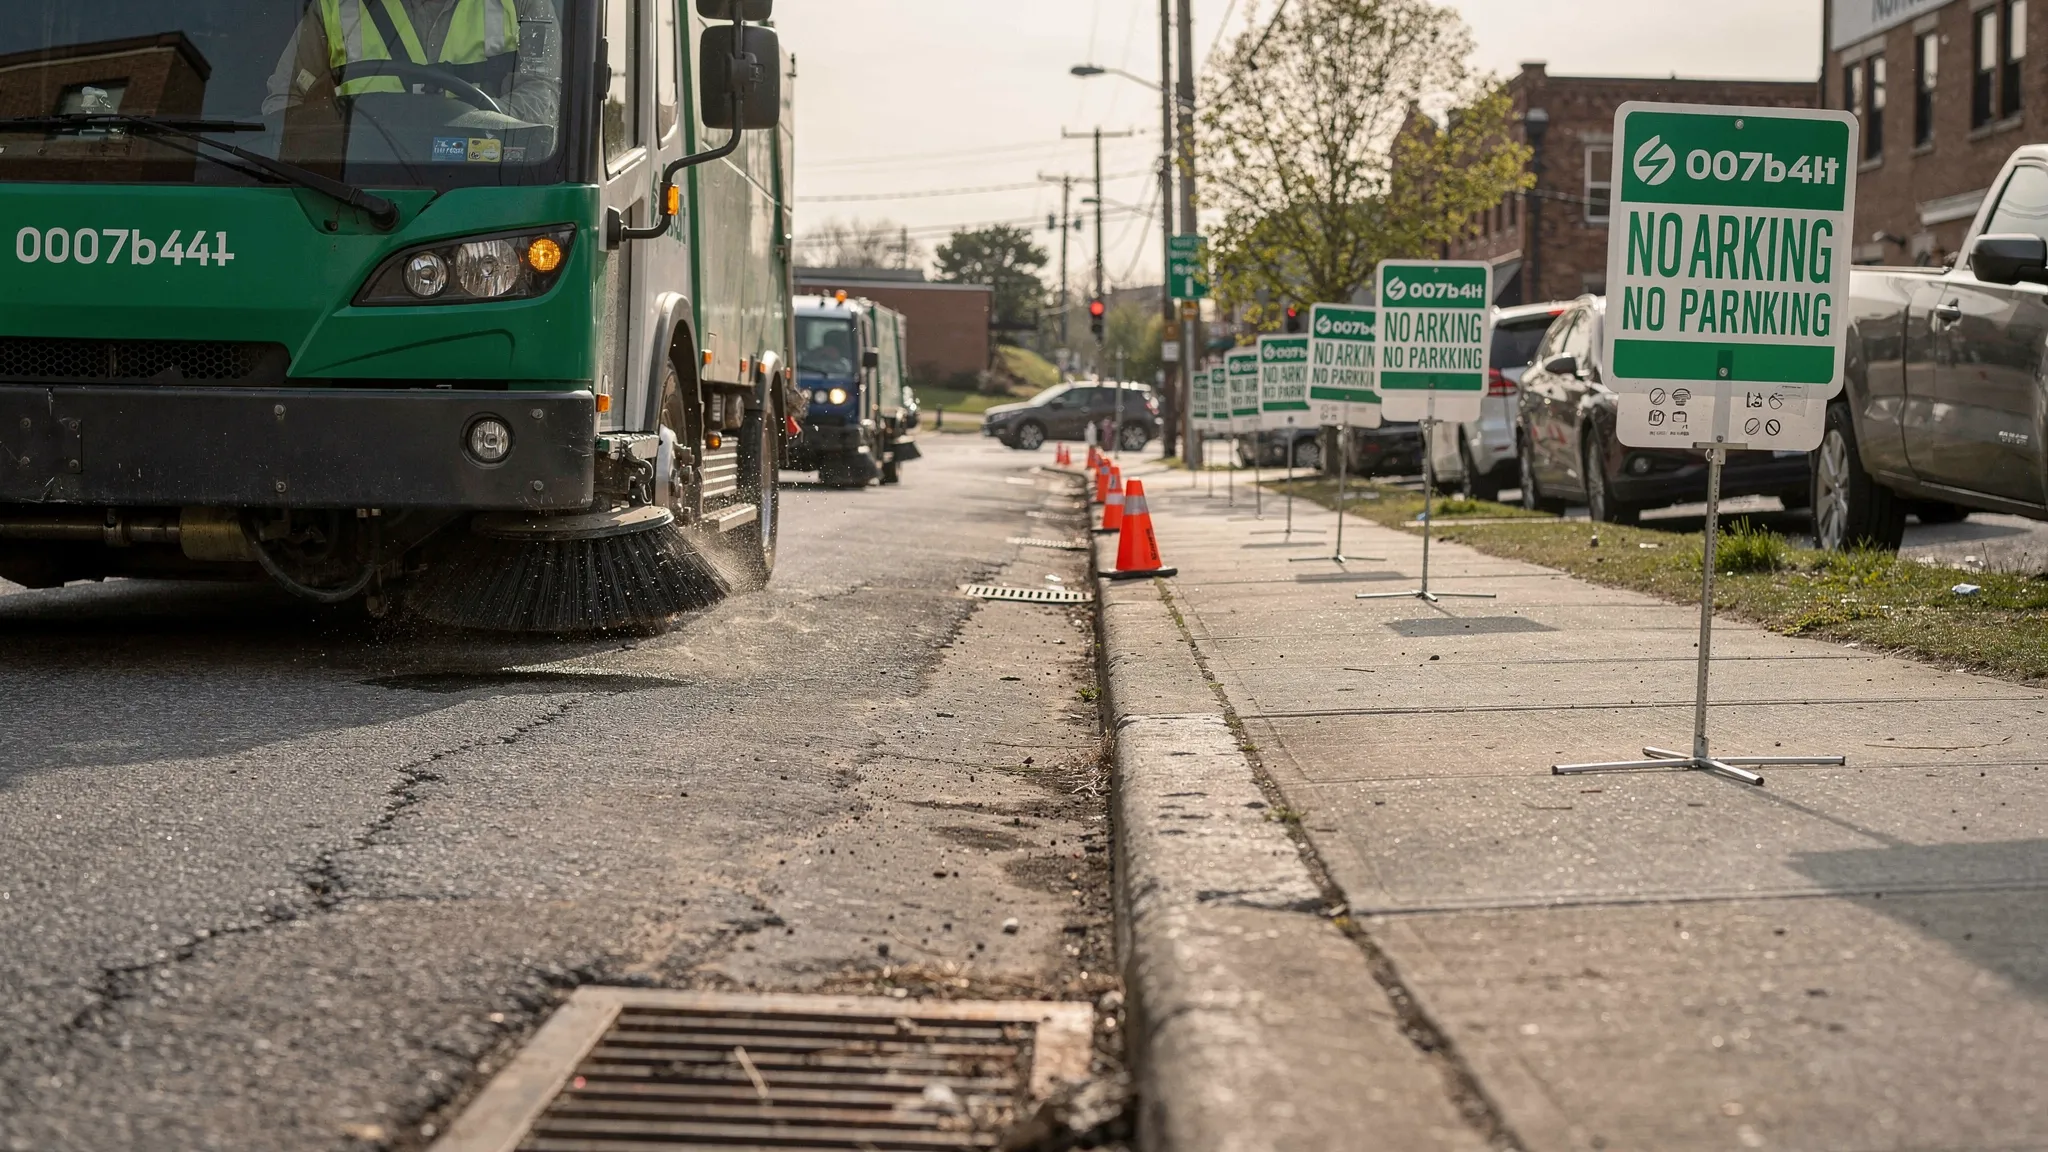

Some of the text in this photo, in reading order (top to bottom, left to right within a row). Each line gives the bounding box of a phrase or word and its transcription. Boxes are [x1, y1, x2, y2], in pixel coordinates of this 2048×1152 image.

[1626, 211, 1833, 284] NO ARKING
[1622, 286, 1832, 337] NO PARNKING
[1384, 312, 1482, 344] NO ARKING
[1314, 342, 1375, 368] NO ARKIN
[1383, 346, 1483, 370] NO PARKKING
[1312, 367, 1328, 384] NO
